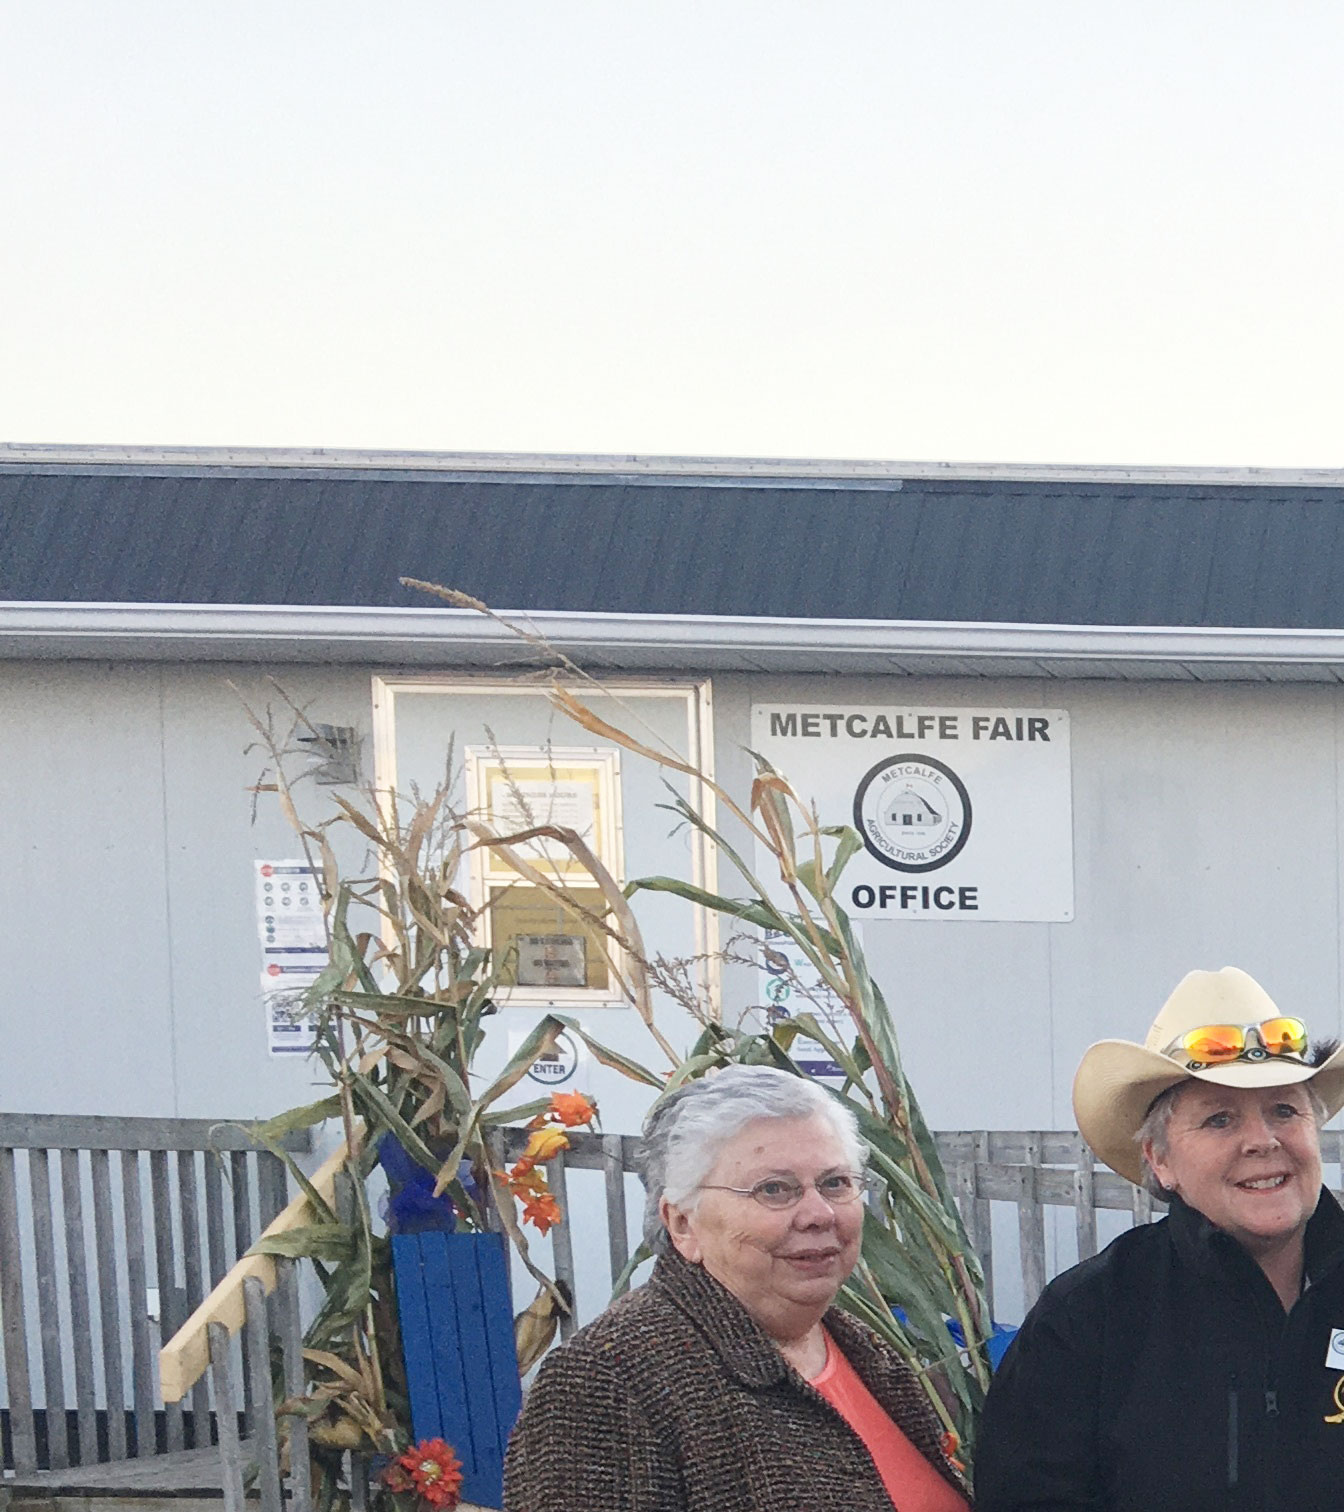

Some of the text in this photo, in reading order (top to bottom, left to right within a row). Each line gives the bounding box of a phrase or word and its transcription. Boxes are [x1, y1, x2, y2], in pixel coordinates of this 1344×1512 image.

[770, 713, 1051, 742] METCALFE FAIR
[881, 766, 943, 785] METCALFE
[867, 819, 960, 861] AGRICULTURAL SOCIETY
[851, 884, 979, 911] OFFICE
[533, 1063, 566, 1074] ENTER
